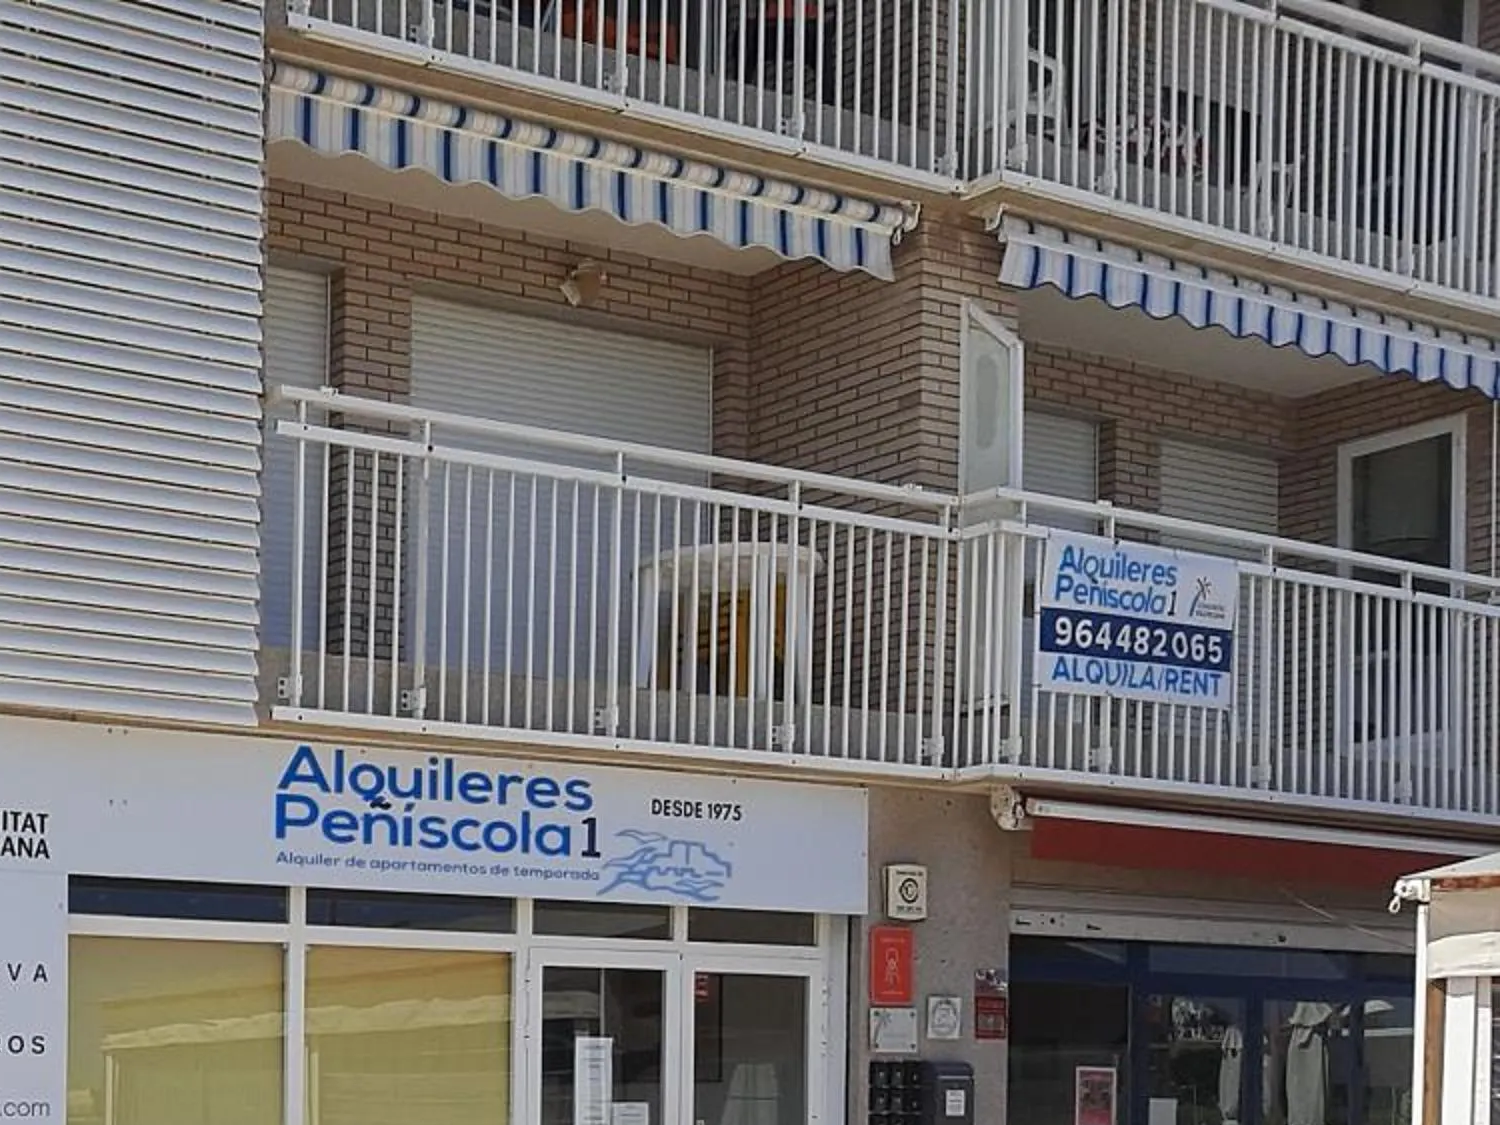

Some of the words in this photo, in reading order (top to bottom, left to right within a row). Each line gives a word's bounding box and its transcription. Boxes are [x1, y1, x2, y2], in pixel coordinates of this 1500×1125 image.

[1058, 544, 1178, 588] Alquileres
[1054, 615, 1224, 665] 964482065
[276, 744, 594, 811] Alquileres
[651, 798, 703, 819] DESDE
[707, 803, 742, 821] 1975
[276, 851, 342, 867] Alquiler
[345, 857, 366, 869] de
[369, 858, 487, 876] apartamentos
[490, 864, 509, 876] de
[514, 866, 600, 882] temporada
